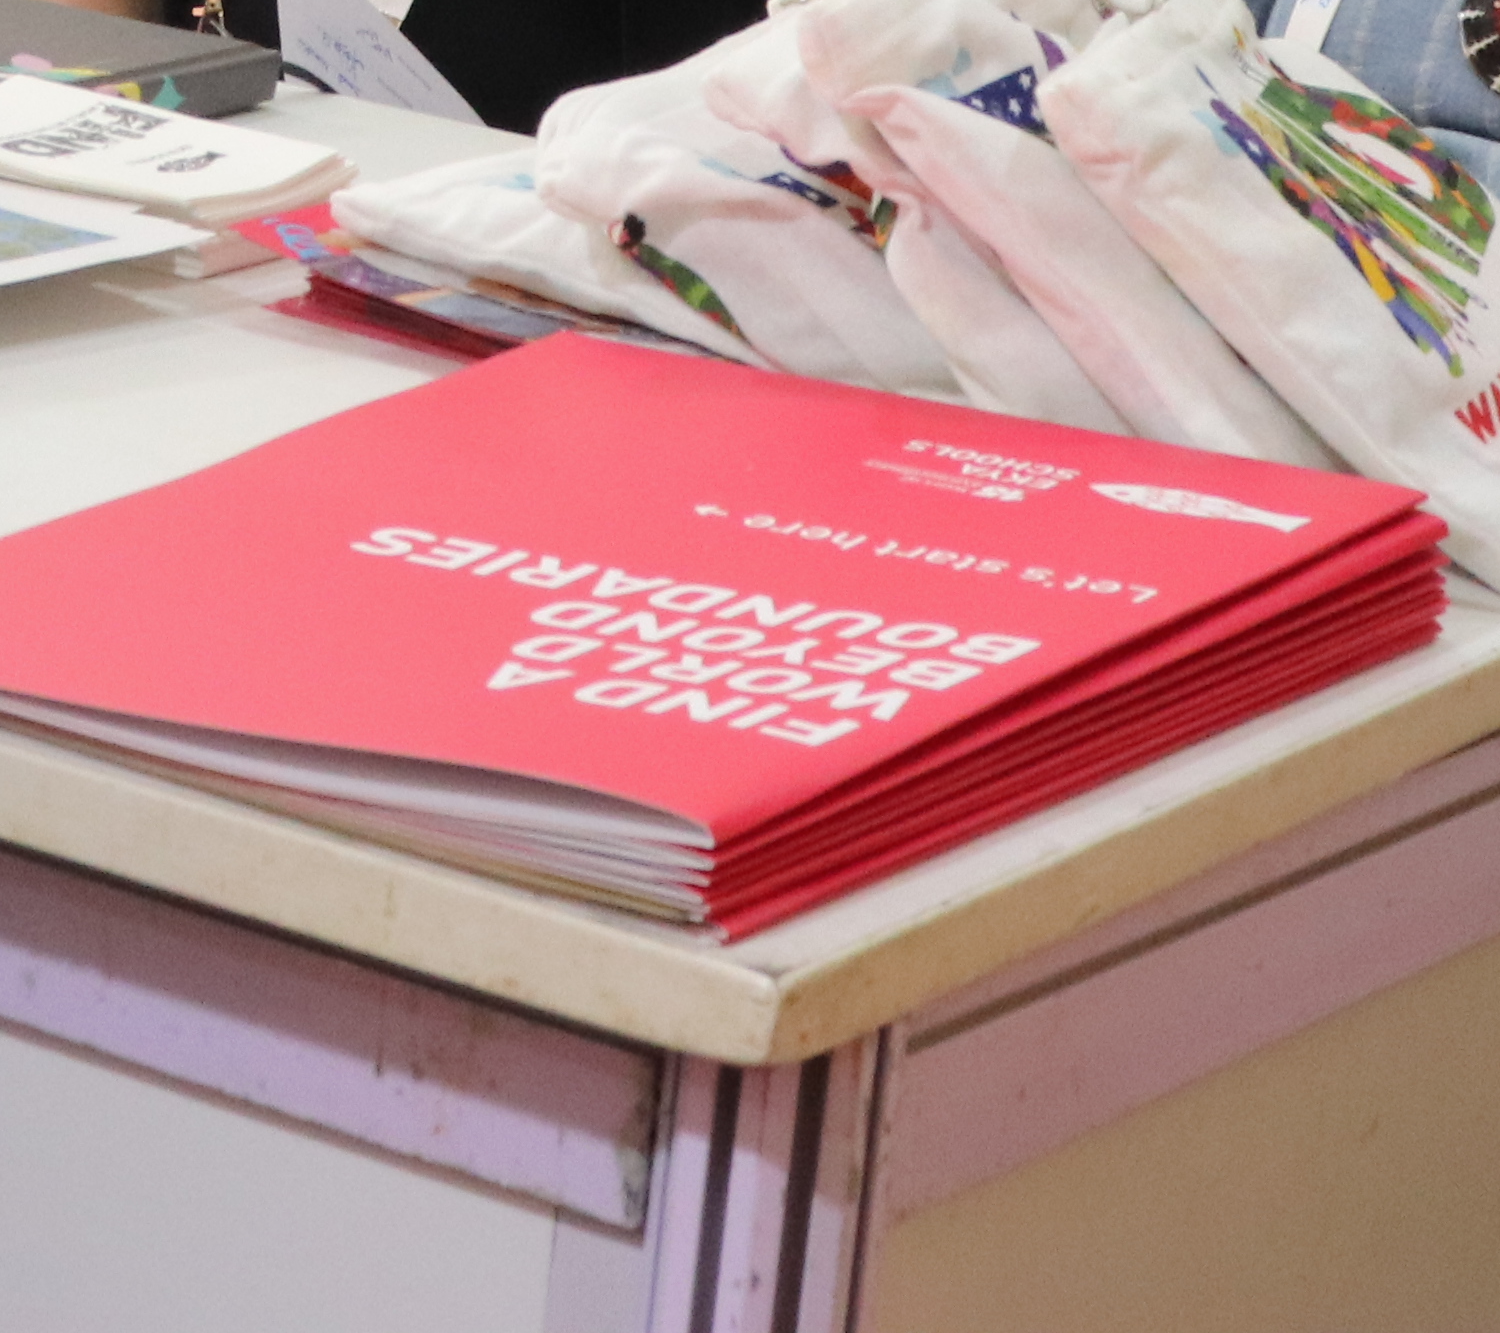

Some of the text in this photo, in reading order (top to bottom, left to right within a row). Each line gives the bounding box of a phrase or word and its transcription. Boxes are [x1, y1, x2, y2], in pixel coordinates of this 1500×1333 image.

[340, 526, 1042, 667] BOUNDARIES
[743, 512, 1160, 604] Let's start here
[512, 633, 912, 722] WORLD
[529, 598, 983, 691] BEYOND
[486, 659, 861, 748] FIND A
